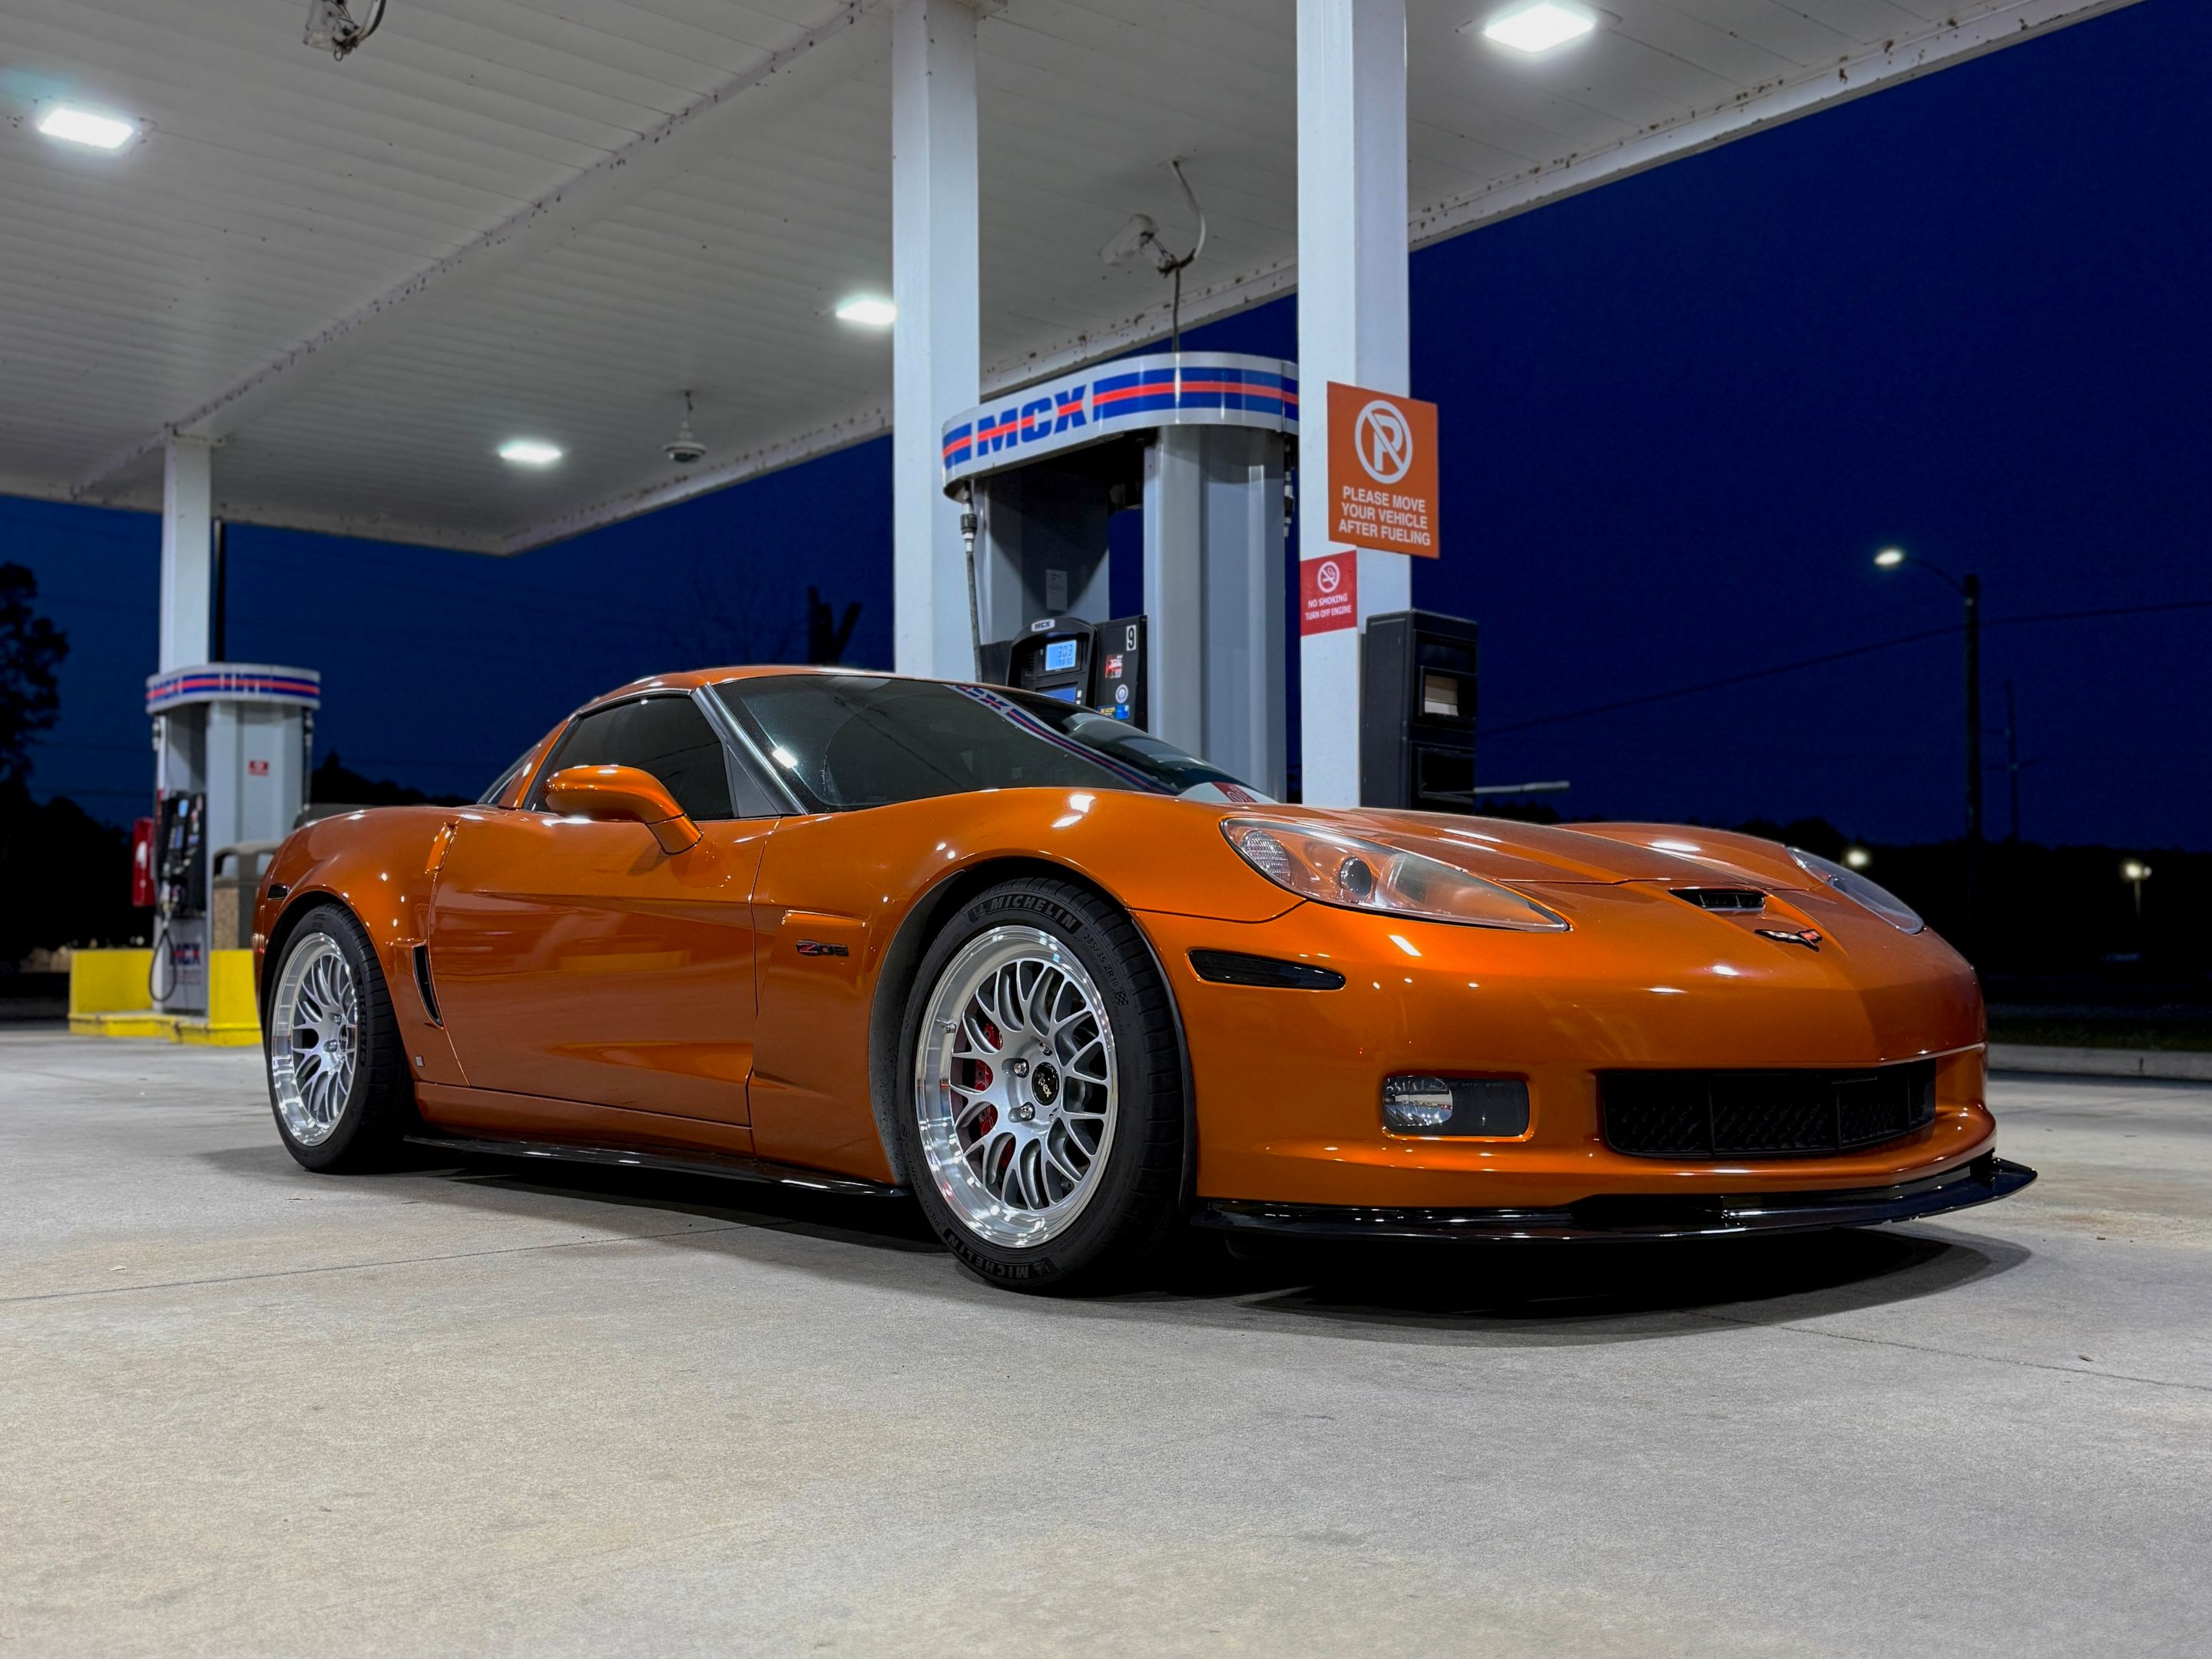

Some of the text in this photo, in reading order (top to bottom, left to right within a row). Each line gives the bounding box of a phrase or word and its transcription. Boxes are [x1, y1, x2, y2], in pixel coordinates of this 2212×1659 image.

[977, 384, 1087, 457] MCX
[1343, 485, 1426, 513] PLEASE MOVE
[1341, 502, 1428, 529] YOUR VEHICLE
[1339, 518, 1431, 546] AFTER FUELING
[1305, 604, 1352, 621] TURN OFF ENGINE
[1308, 593, 1348, 608] NO SMOKING
[1035, 621, 1051, 629] MCX
[1128, 627, 1135, 649] 9
[990, 895, 1078, 930] MICHELIN
[1082, 933, 1108, 962] 285/35
[947, 1236, 1030, 1279] MICHELIN
